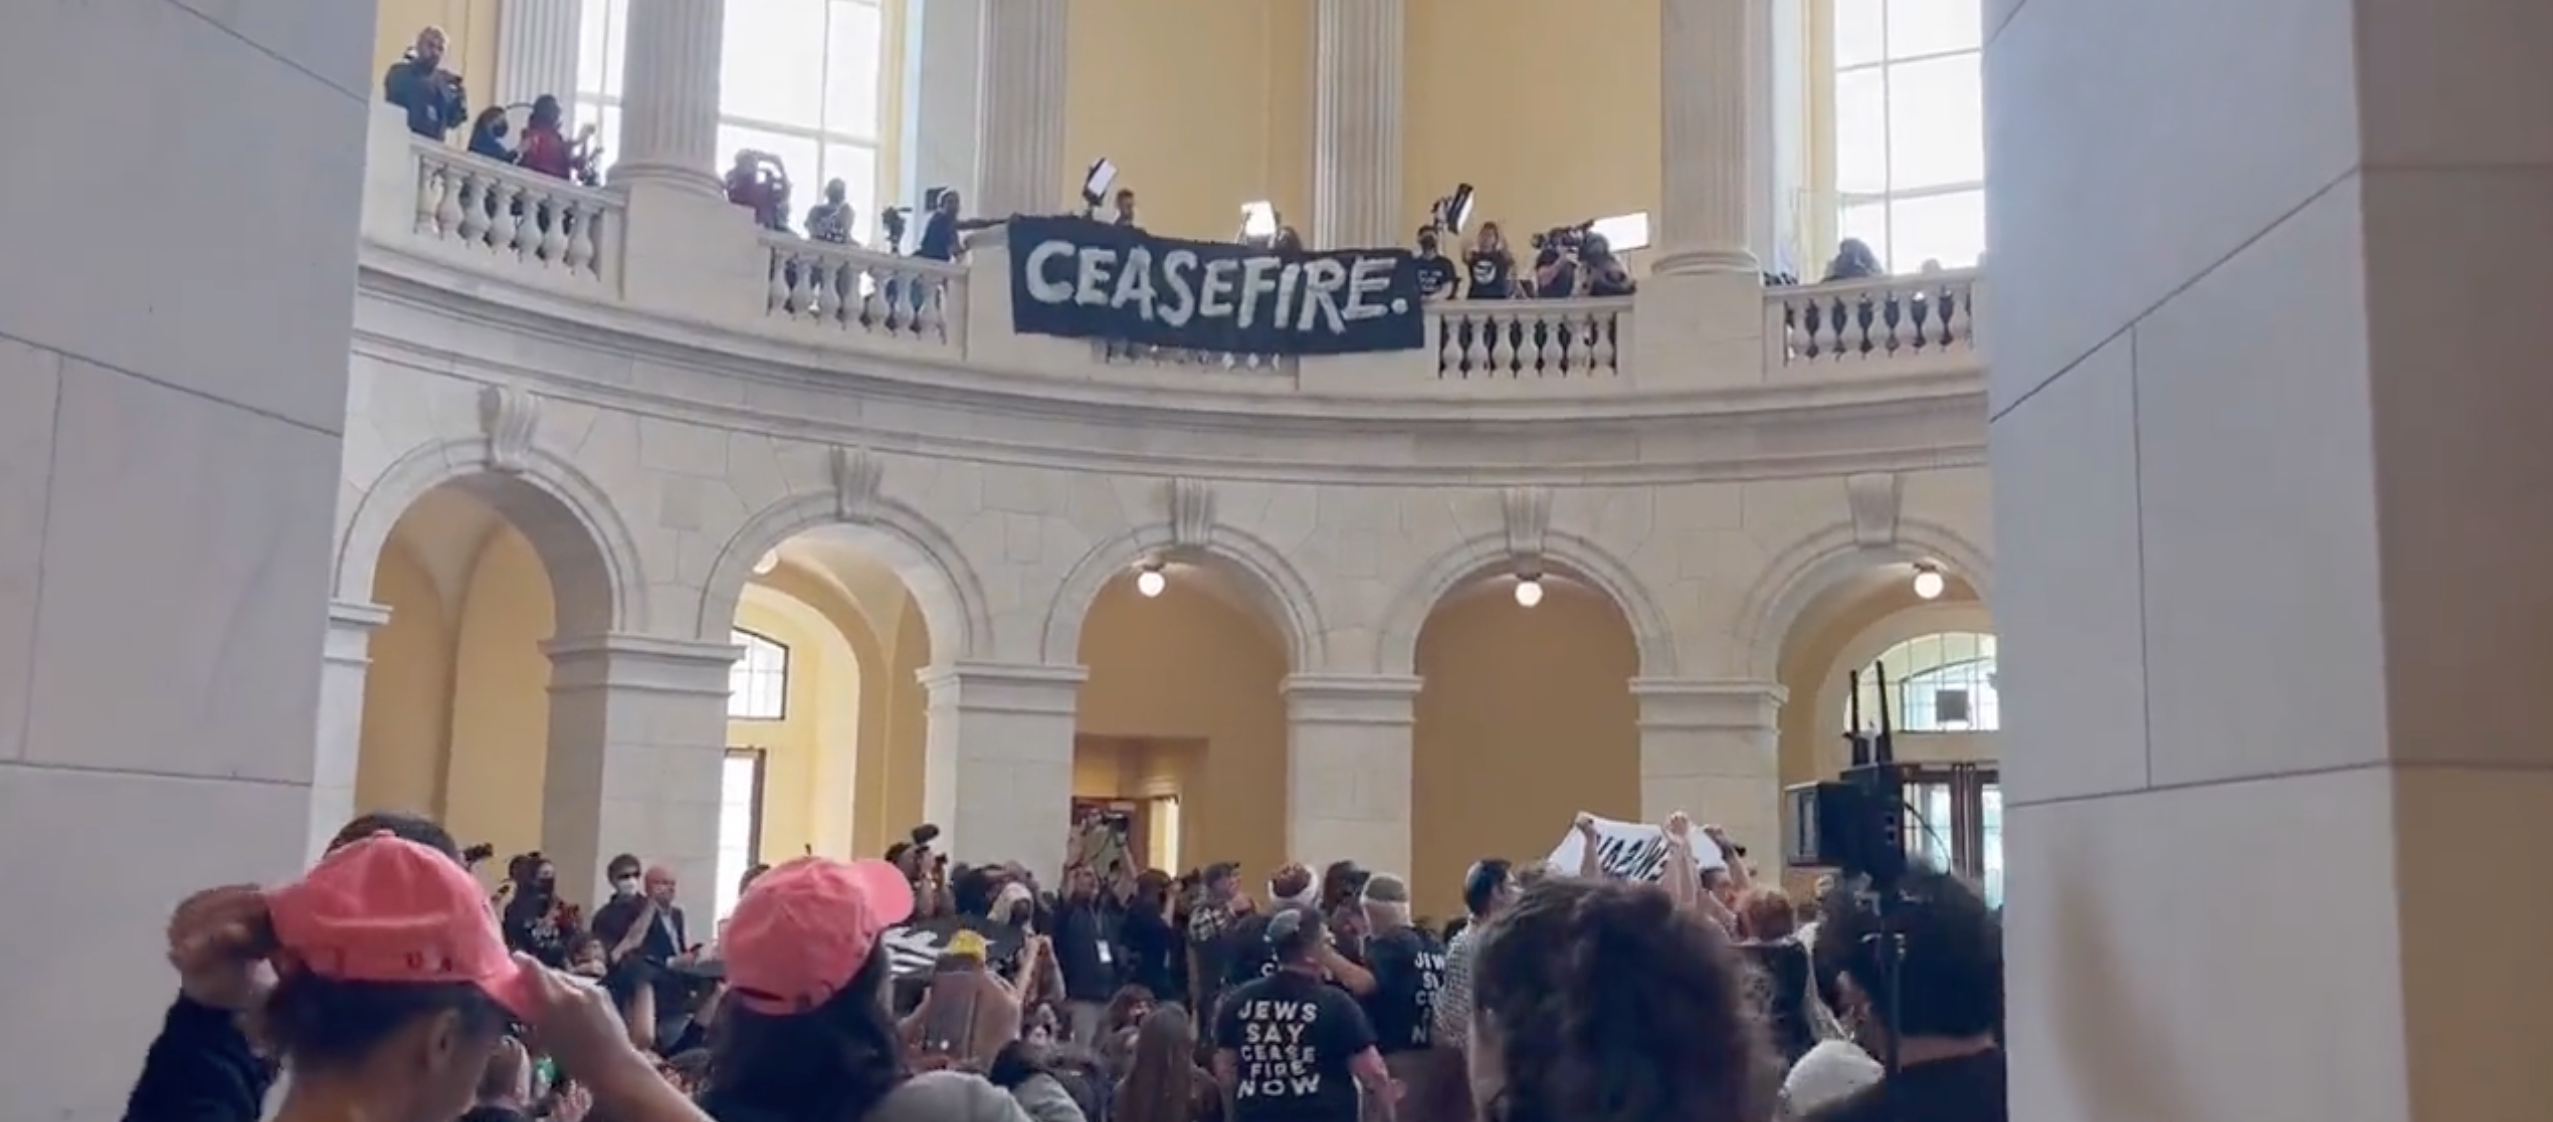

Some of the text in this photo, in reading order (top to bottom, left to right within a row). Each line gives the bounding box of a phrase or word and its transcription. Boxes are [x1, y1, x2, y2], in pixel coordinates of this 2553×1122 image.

[1025, 239, 1409, 335] CEASEFIRE.
[1237, 1000, 1318, 1023] JEWS
[1246, 1022, 1306, 1044] SAY
[1241, 1045, 1316, 1063] CEASE
[1251, 1060, 1307, 1079] FIRE
[1237, 1073, 1321, 1099] NOW
